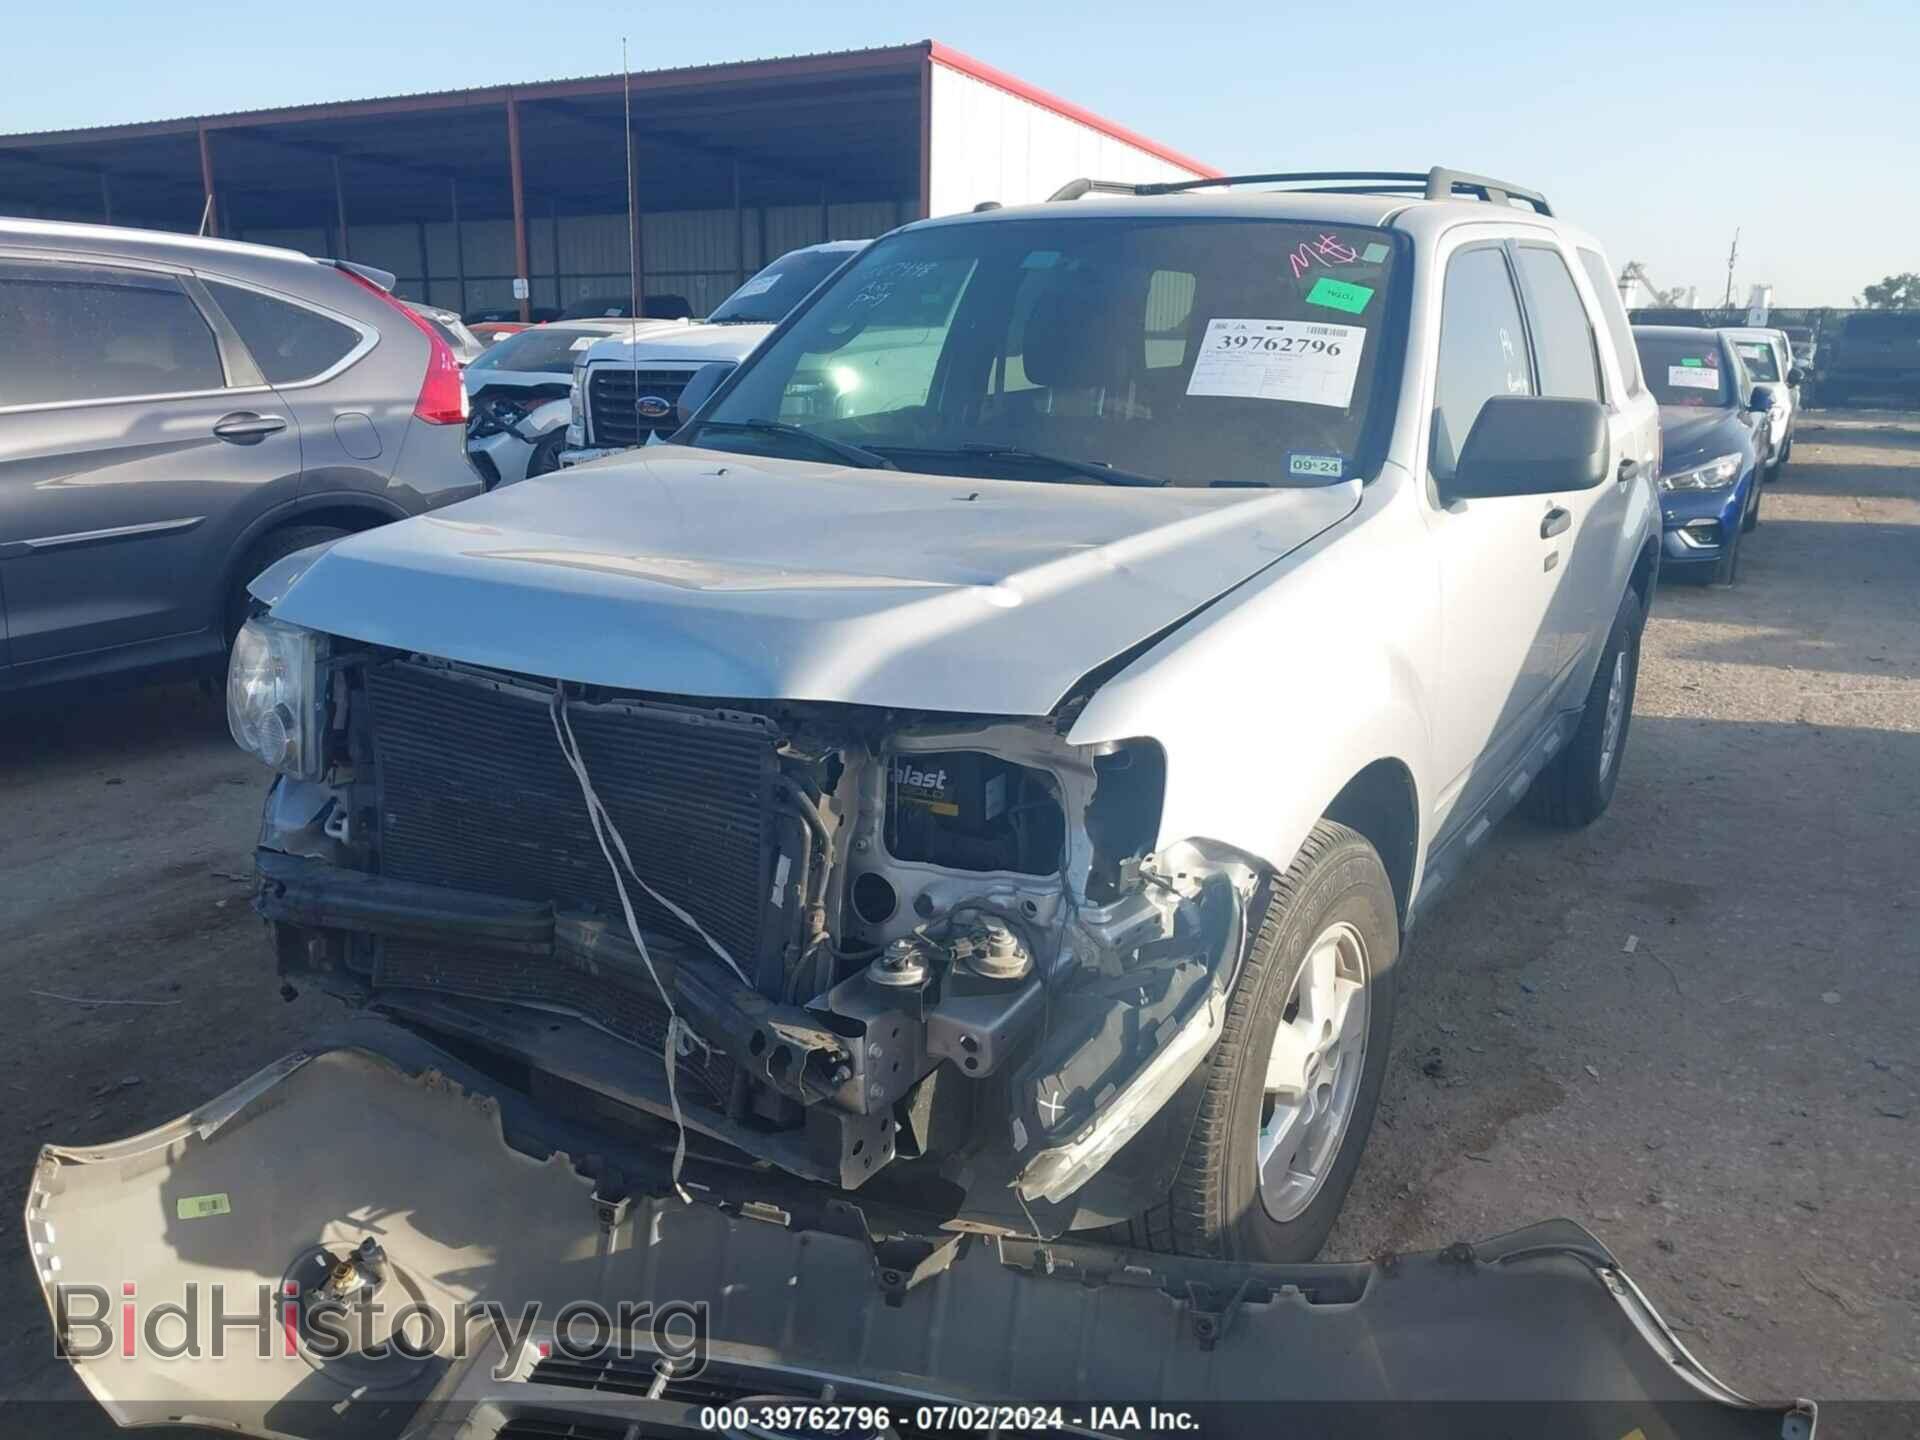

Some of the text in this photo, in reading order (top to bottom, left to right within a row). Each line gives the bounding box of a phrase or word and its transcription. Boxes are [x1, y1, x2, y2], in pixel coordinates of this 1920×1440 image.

[1216, 335, 1342, 356] 39762796
[1292, 459, 1339, 473] 09 24
[889, 764, 947, 790] alast
